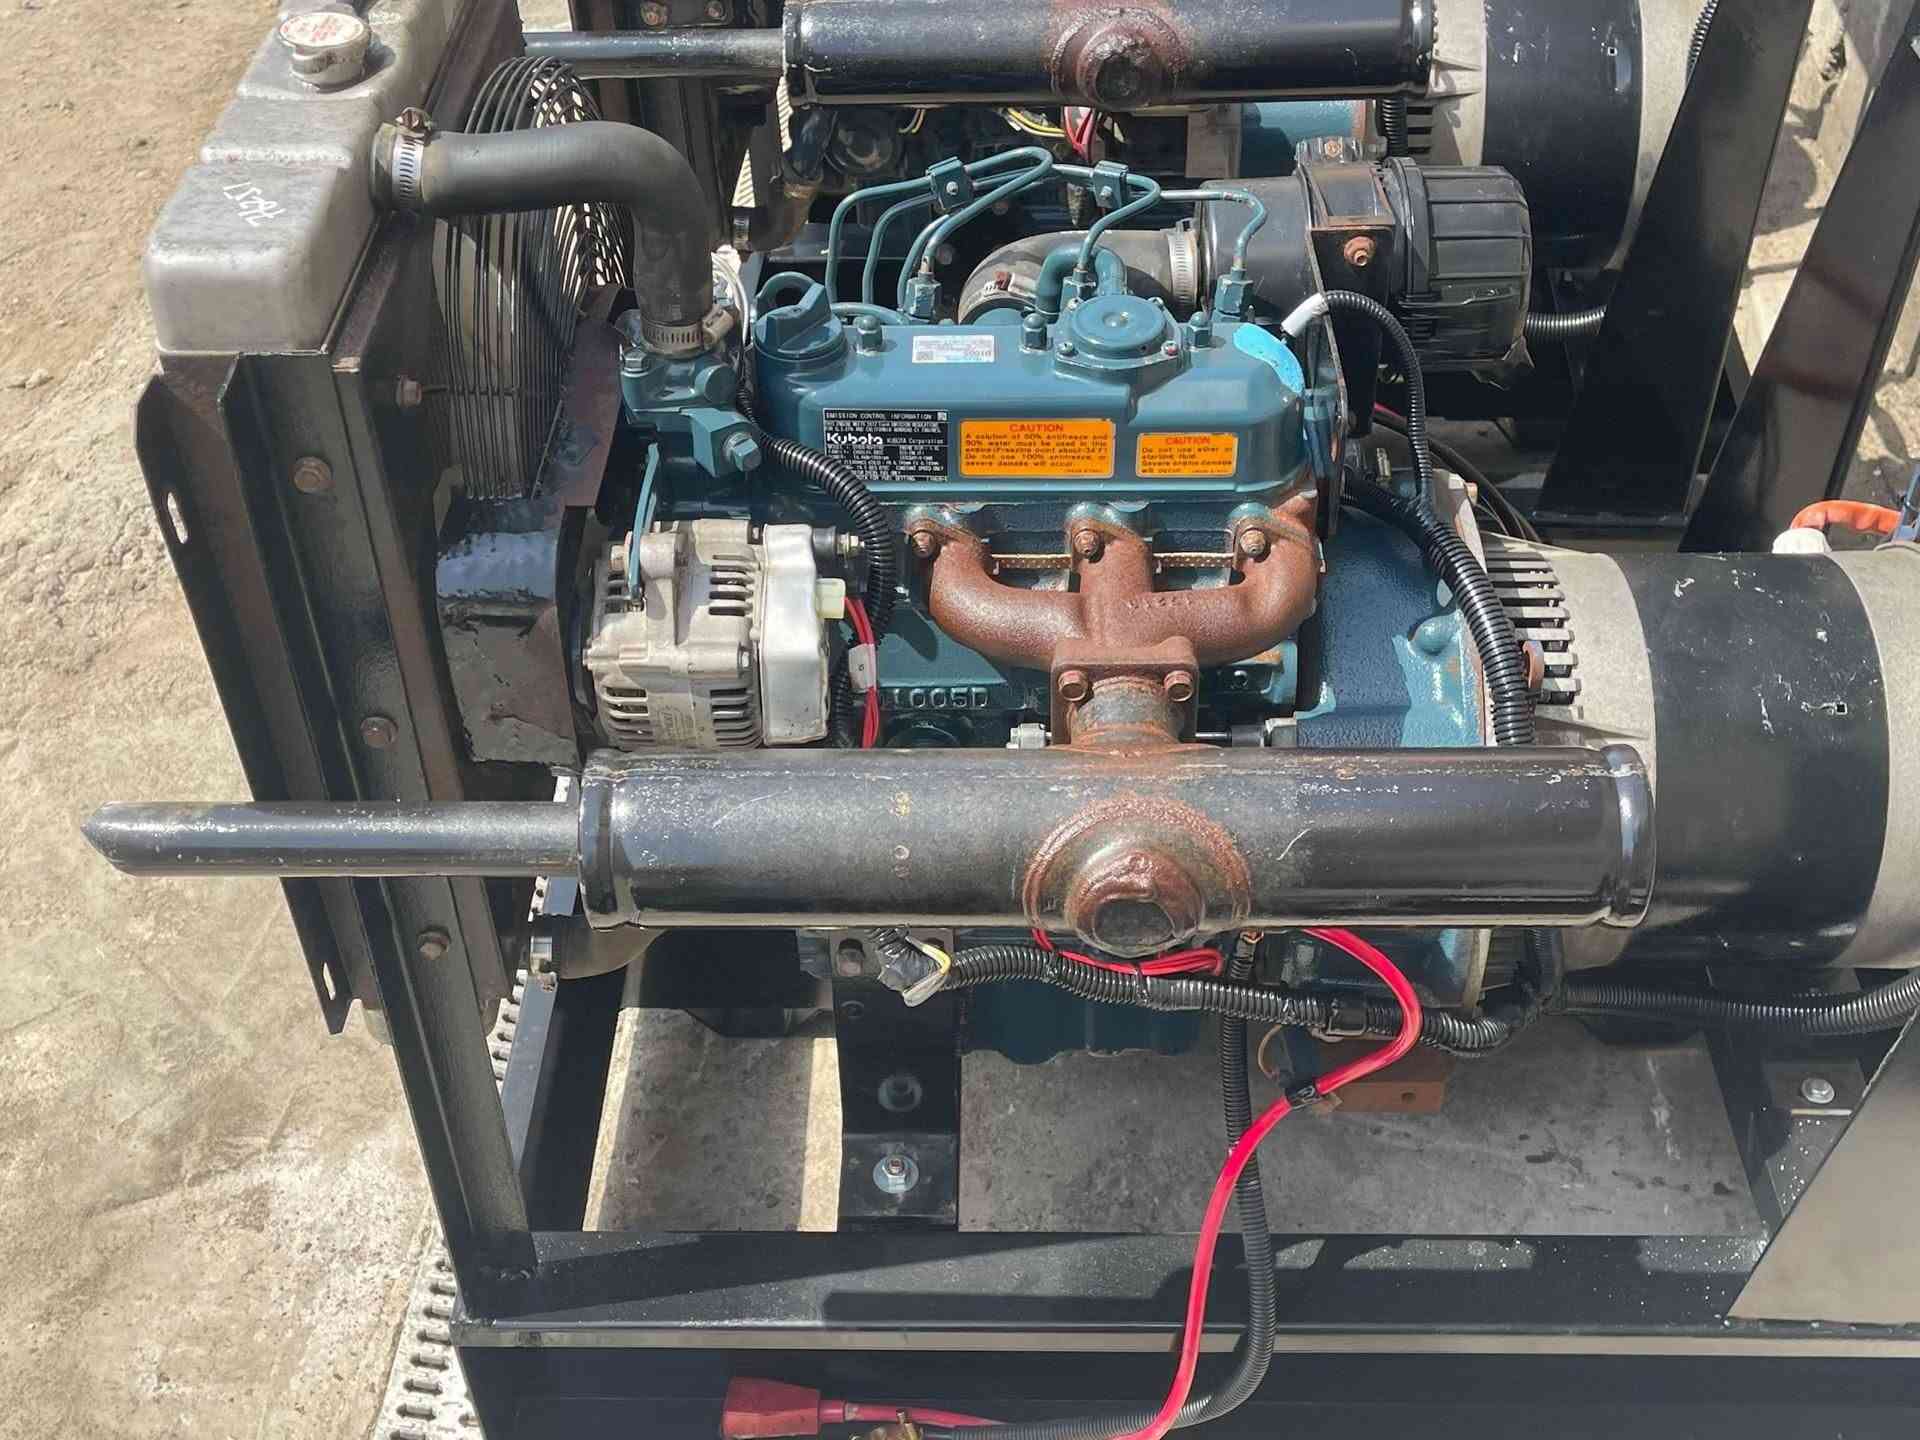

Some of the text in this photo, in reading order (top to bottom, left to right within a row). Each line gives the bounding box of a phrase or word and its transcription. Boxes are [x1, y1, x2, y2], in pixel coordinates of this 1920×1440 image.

[826, 412, 932, 420] EMISSION CONTROL INFORMATION
[1009, 424, 1064, 433] CAUTION
[826, 433, 883, 445] Kubota
[1167, 437, 1211, 445] CAUTION
